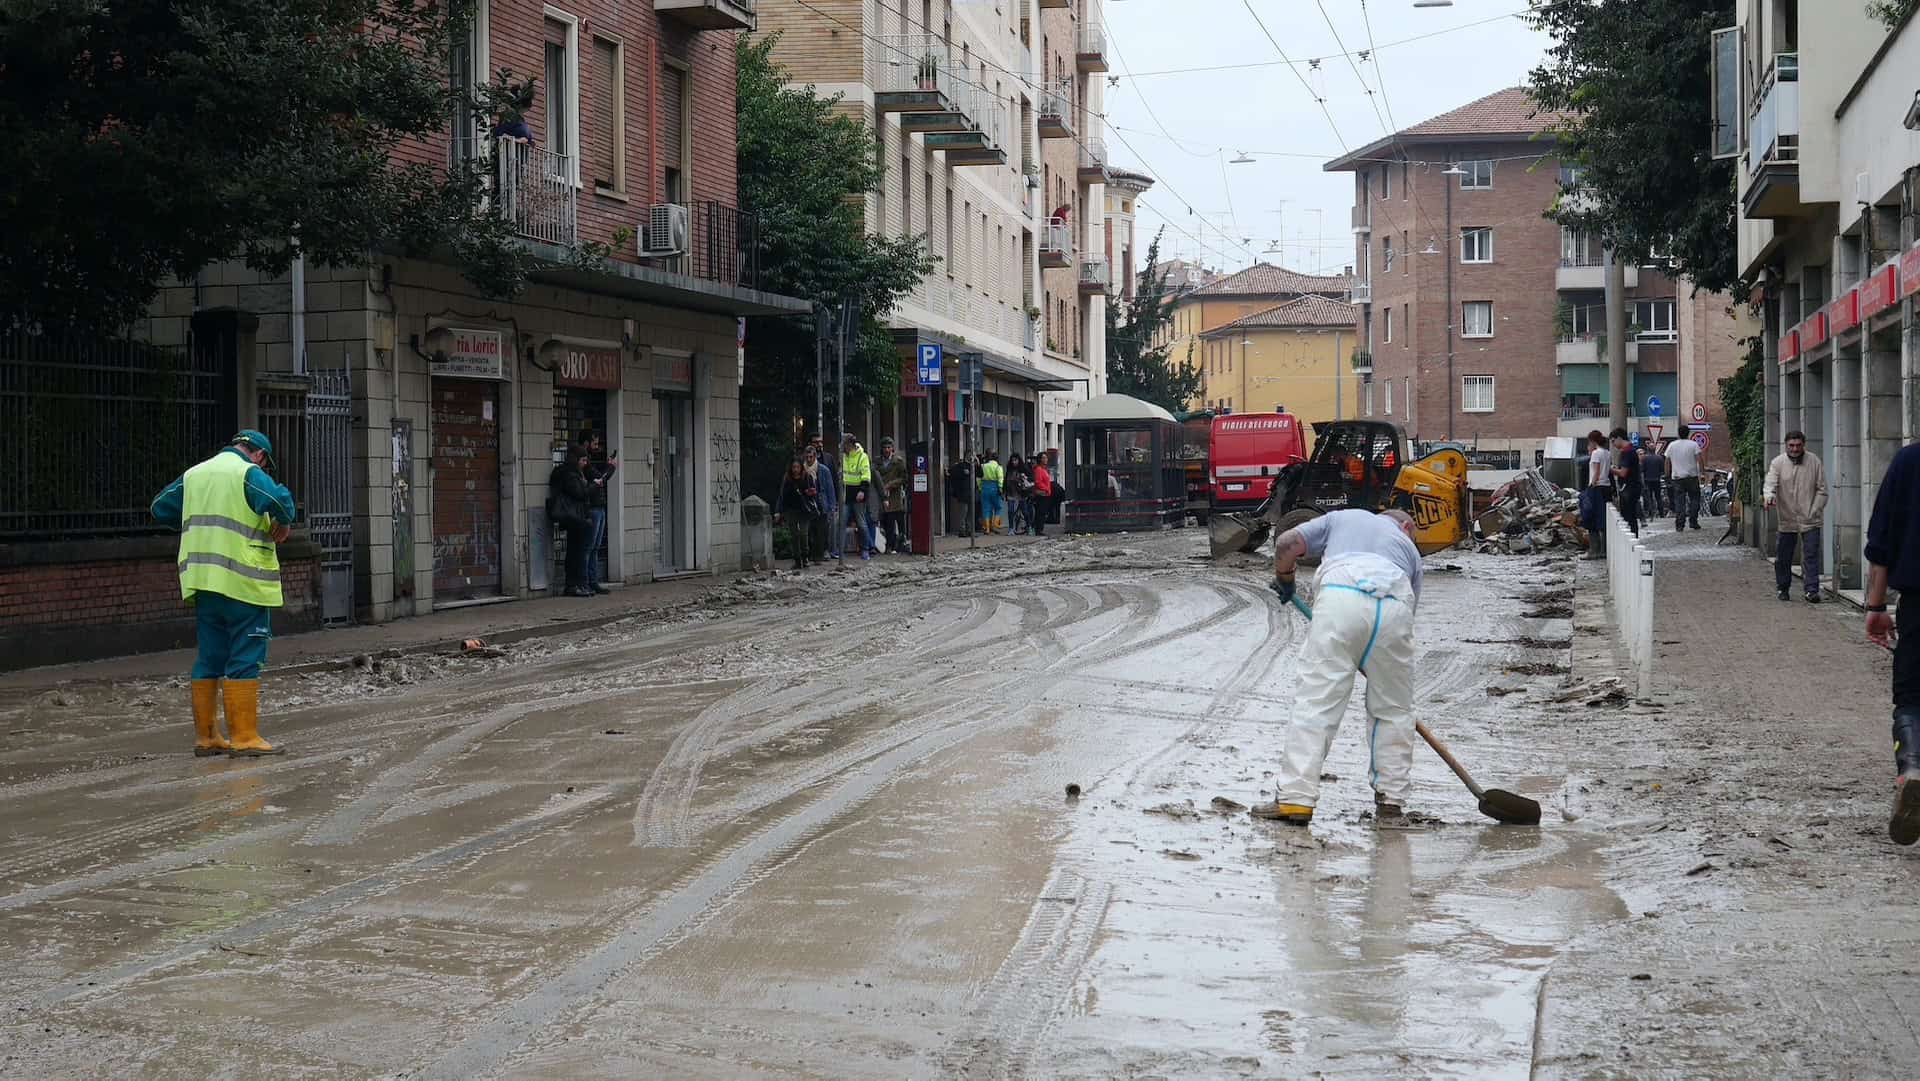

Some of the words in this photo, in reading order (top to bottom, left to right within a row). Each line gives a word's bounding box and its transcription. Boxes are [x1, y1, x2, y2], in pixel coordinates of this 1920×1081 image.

[923, 346, 937, 366] P
[1695, 408, 1703, 418] 10
[1222, 421, 1247, 430] VIGILI
[917, 456, 924, 467] P
